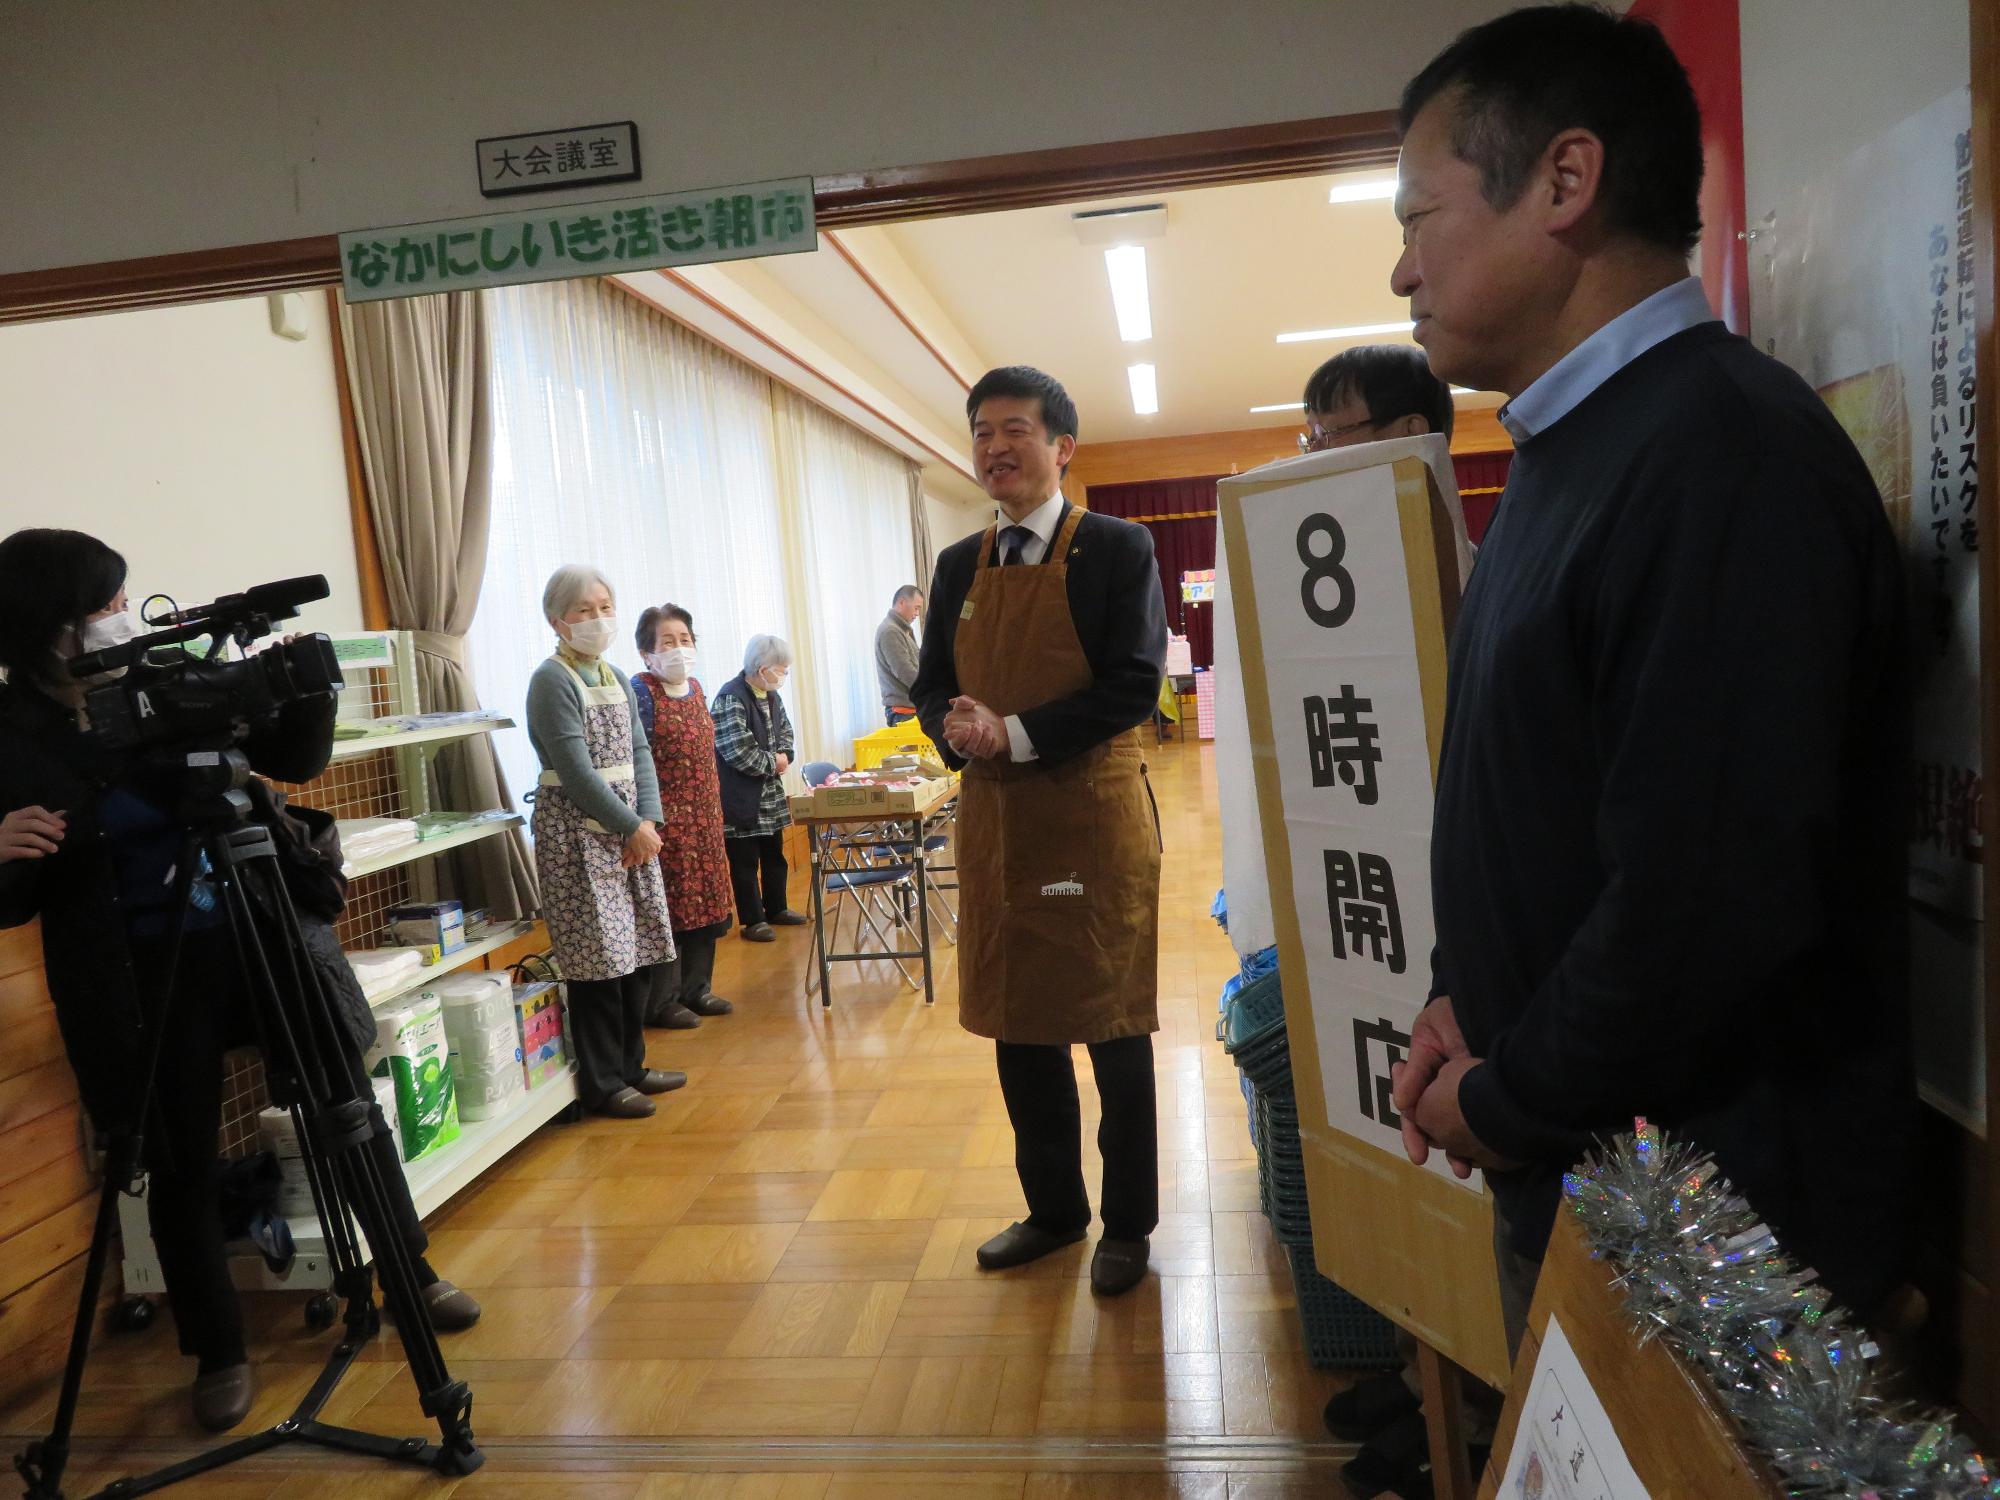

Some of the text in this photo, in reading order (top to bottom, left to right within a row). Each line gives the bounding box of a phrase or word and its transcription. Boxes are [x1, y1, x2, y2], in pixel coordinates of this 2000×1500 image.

[493, 136, 619, 180] 大会議室
[347, 191, 806, 288] なかにしいき活き朝市
[138, 691, 156, 718] A
[1041, 884, 1084, 896] sumika
